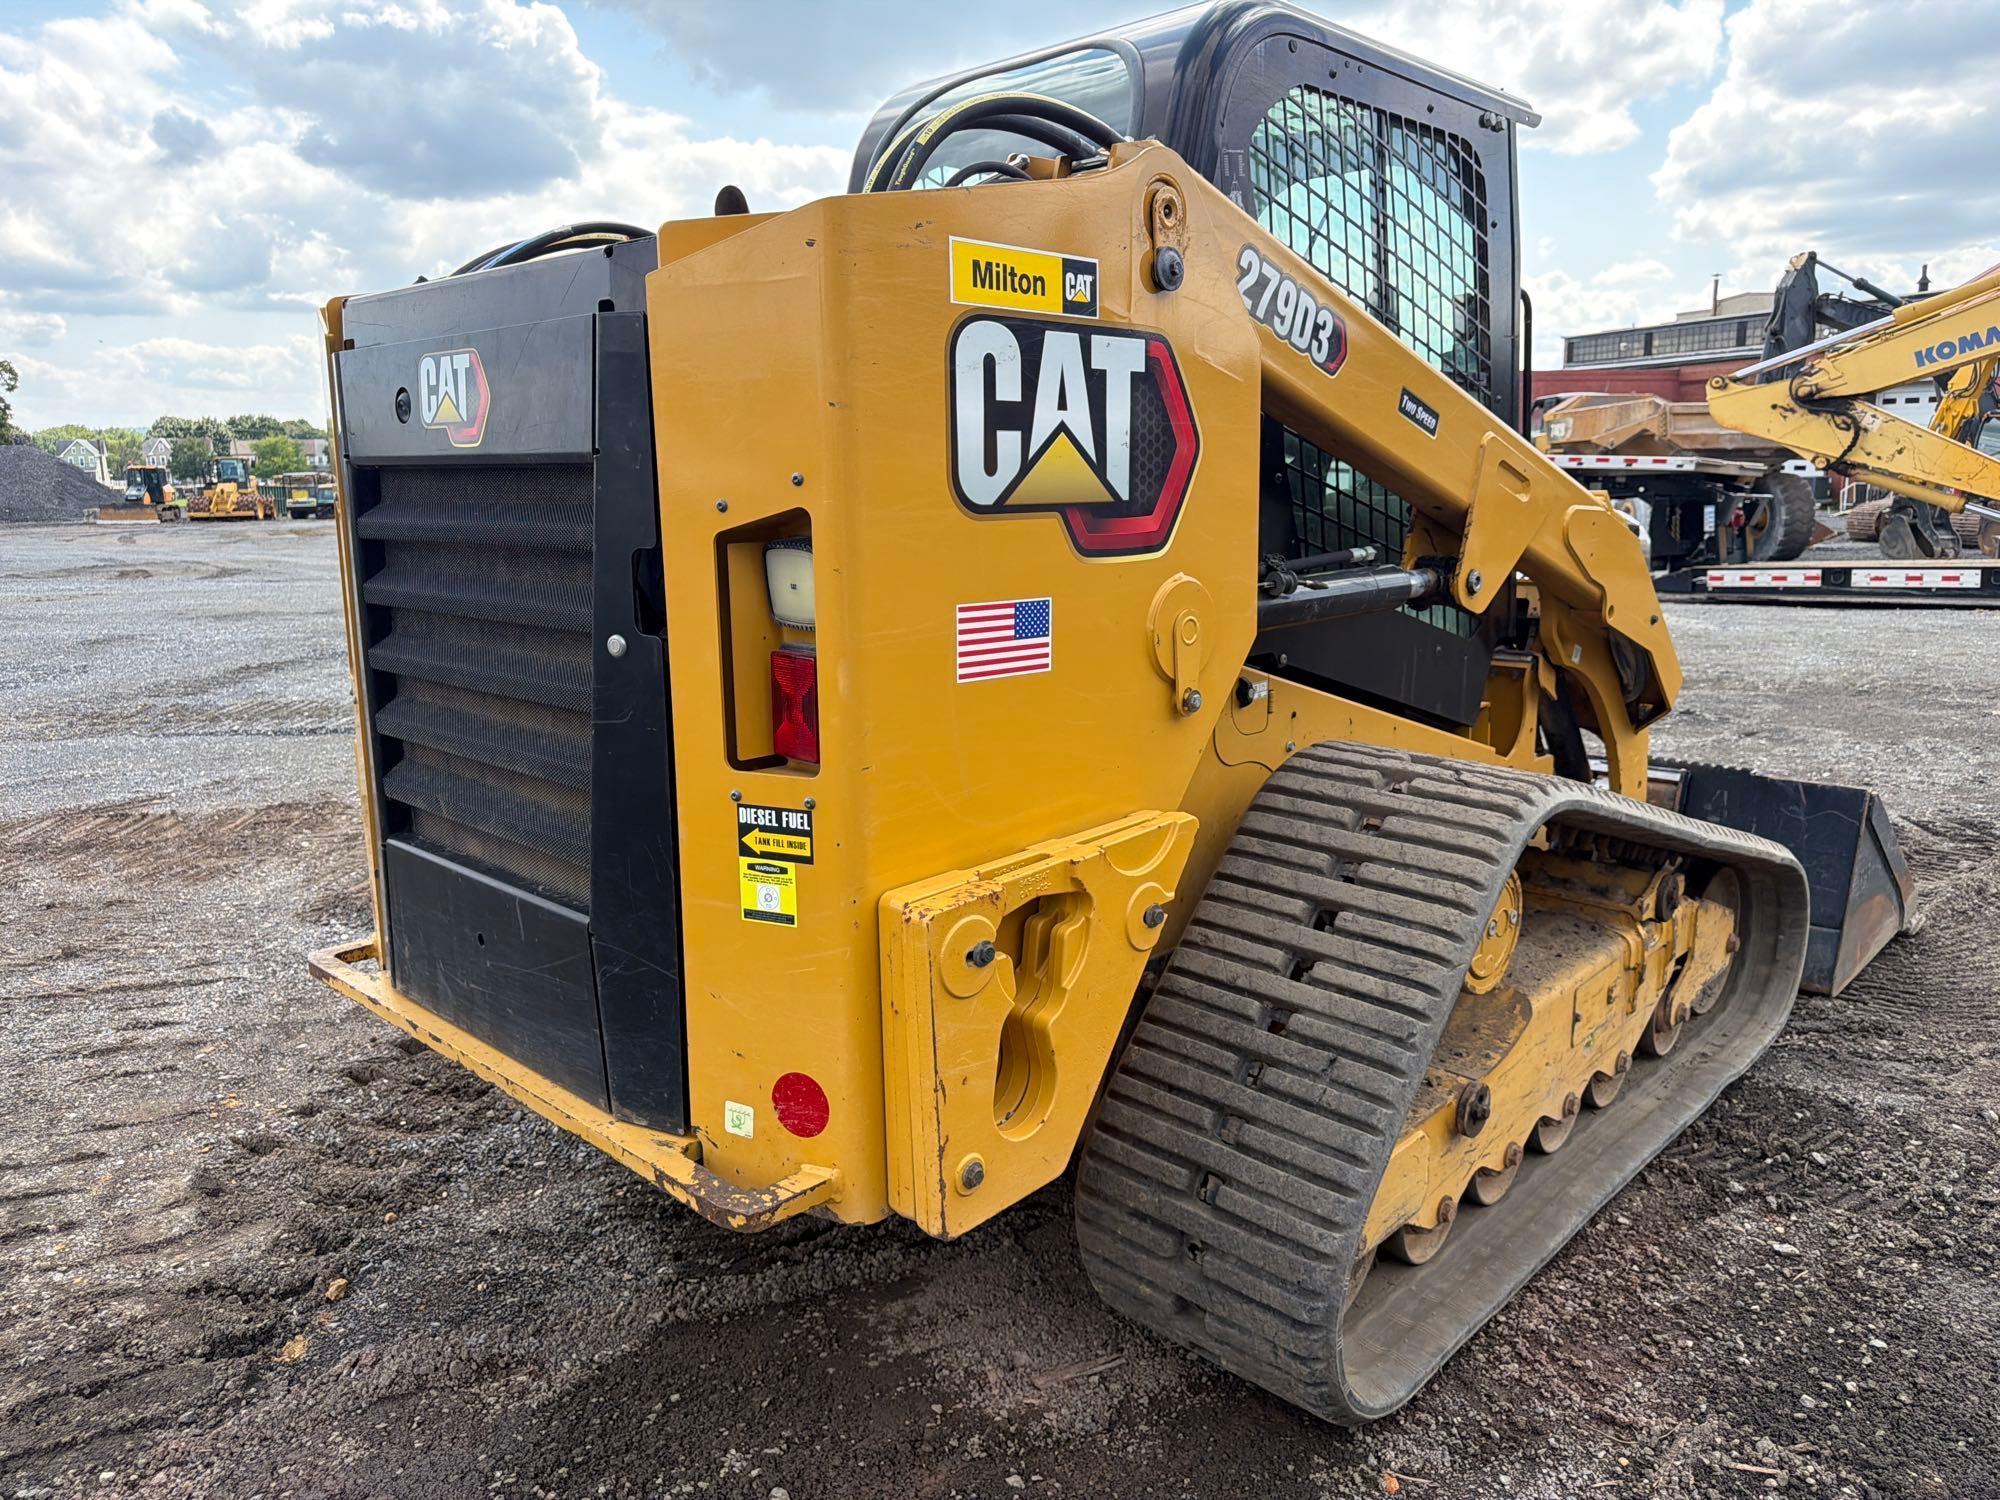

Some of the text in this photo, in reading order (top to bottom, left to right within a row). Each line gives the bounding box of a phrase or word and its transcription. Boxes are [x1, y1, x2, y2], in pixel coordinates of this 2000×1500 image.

[972, 259, 1093, 303] Milton CAT
[1238, 248, 1334, 363] 279D3
[420, 353, 470, 424] CAT
[955, 320, 1146, 506] CAT
[738, 806, 811, 830] DIESEL FUEL
[754, 836, 807, 851] TANK FILL INSIDE
[754, 865, 781, 873] WARNING
